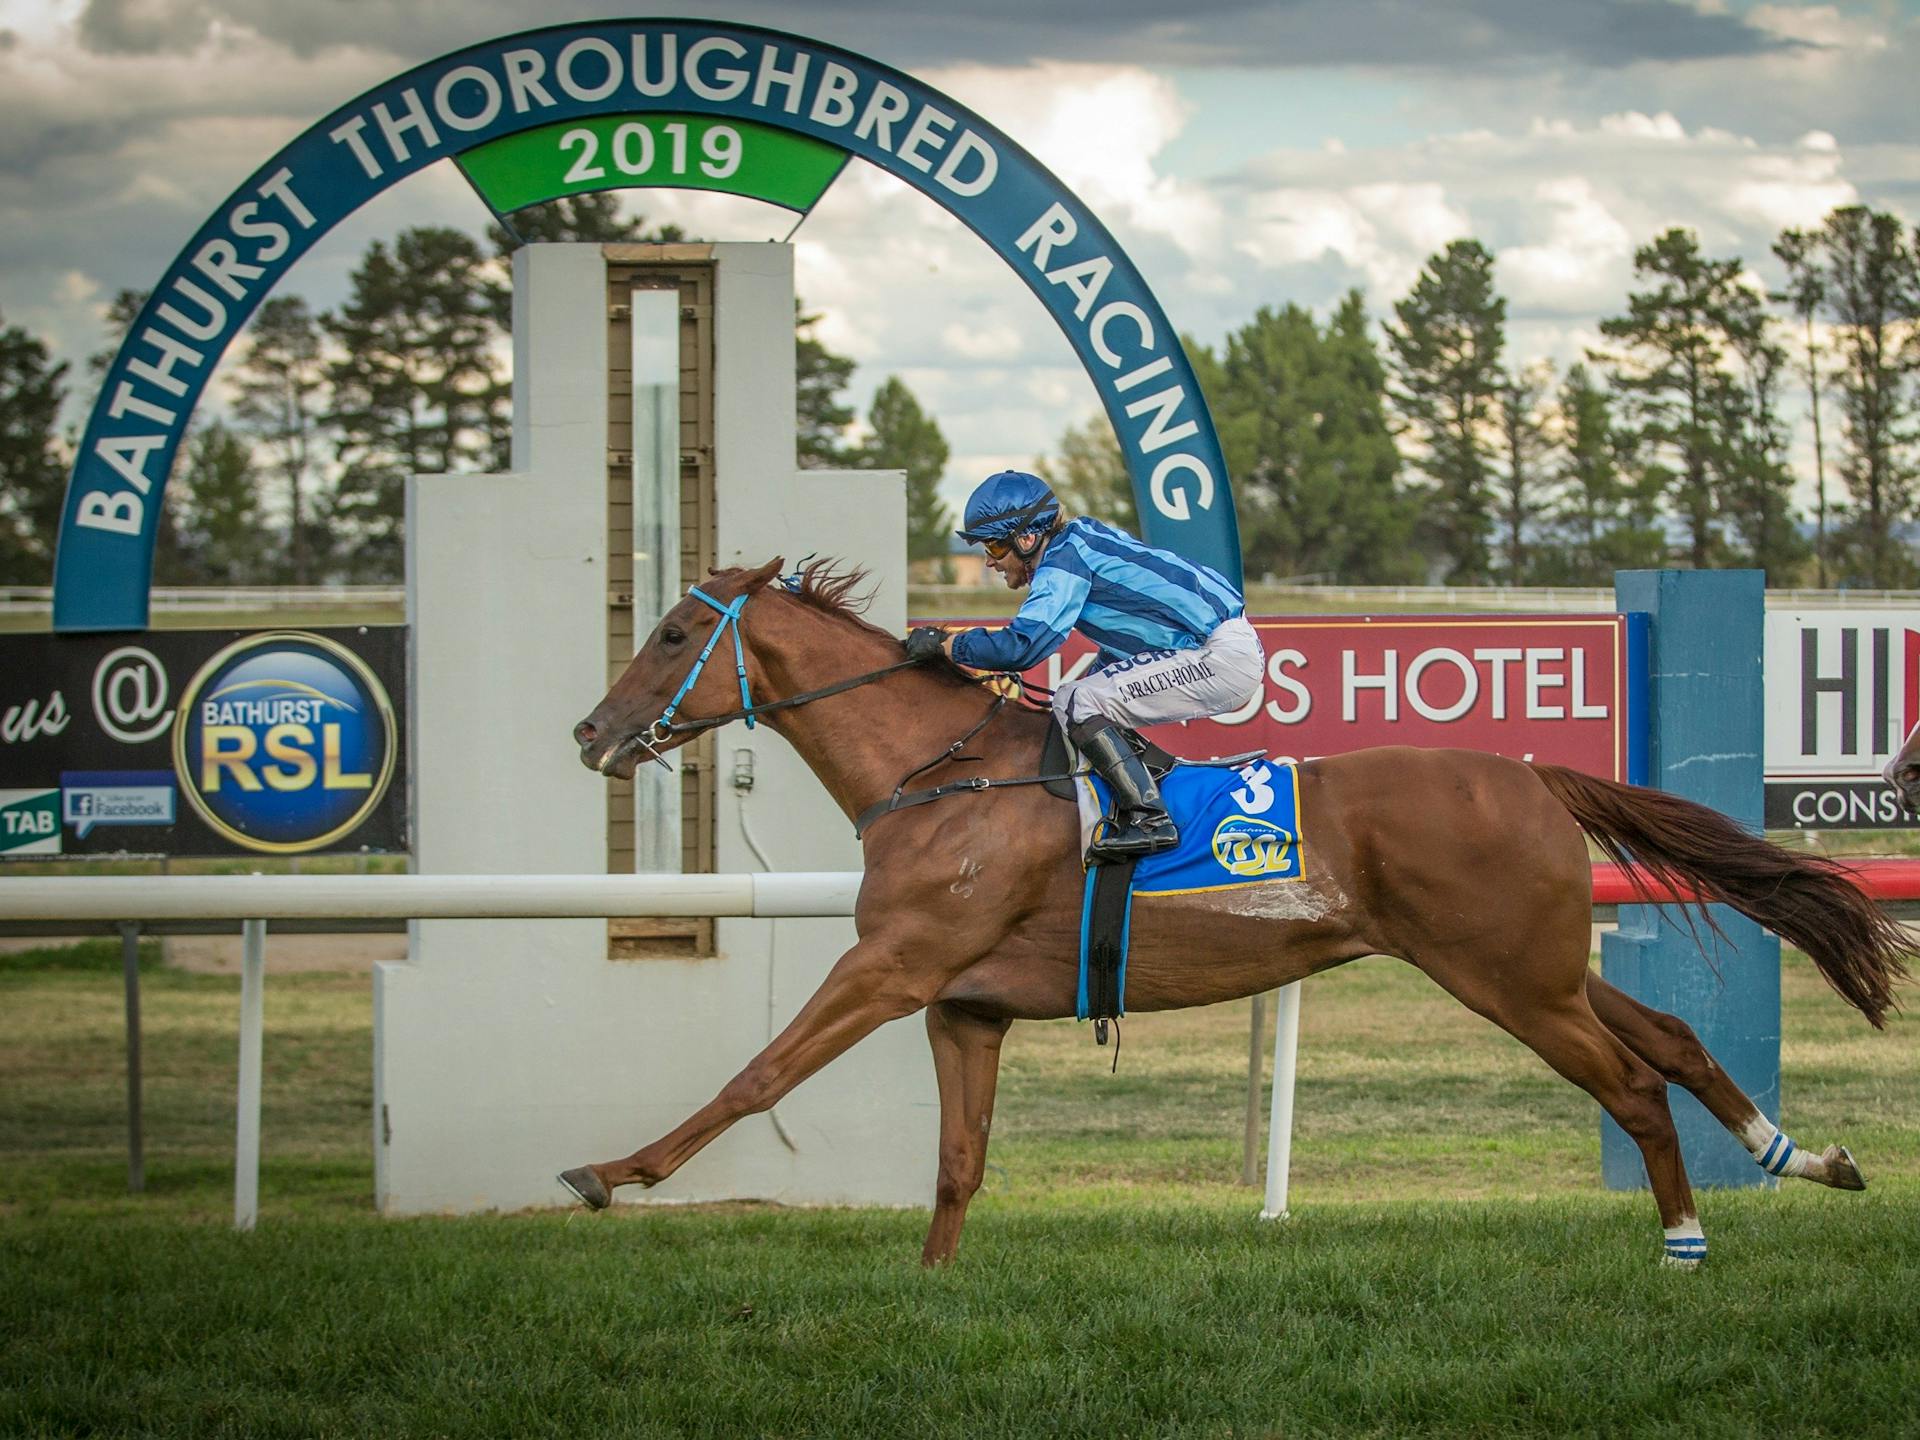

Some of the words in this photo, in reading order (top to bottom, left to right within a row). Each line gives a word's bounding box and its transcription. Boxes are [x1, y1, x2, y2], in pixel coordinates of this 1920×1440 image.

[558, 122, 744, 184] 2019
[76, 167, 318, 536] BATHURST
[329, 34, 999, 197] THOROUGHBRED
[1014, 201, 1214, 521] RACING
[1, 690, 71, 744] us
[91, 646, 176, 744] @
[202, 700, 326, 726] BATHURST
[1341, 647, 1609, 723] HOTEL
[201, 723, 373, 792] RSL
[96, 801, 165, 817] Facebook
[1229, 764, 1275, 815] 3
[1792, 790, 1911, 824] CONS
[2, 809, 55, 835] TAB
